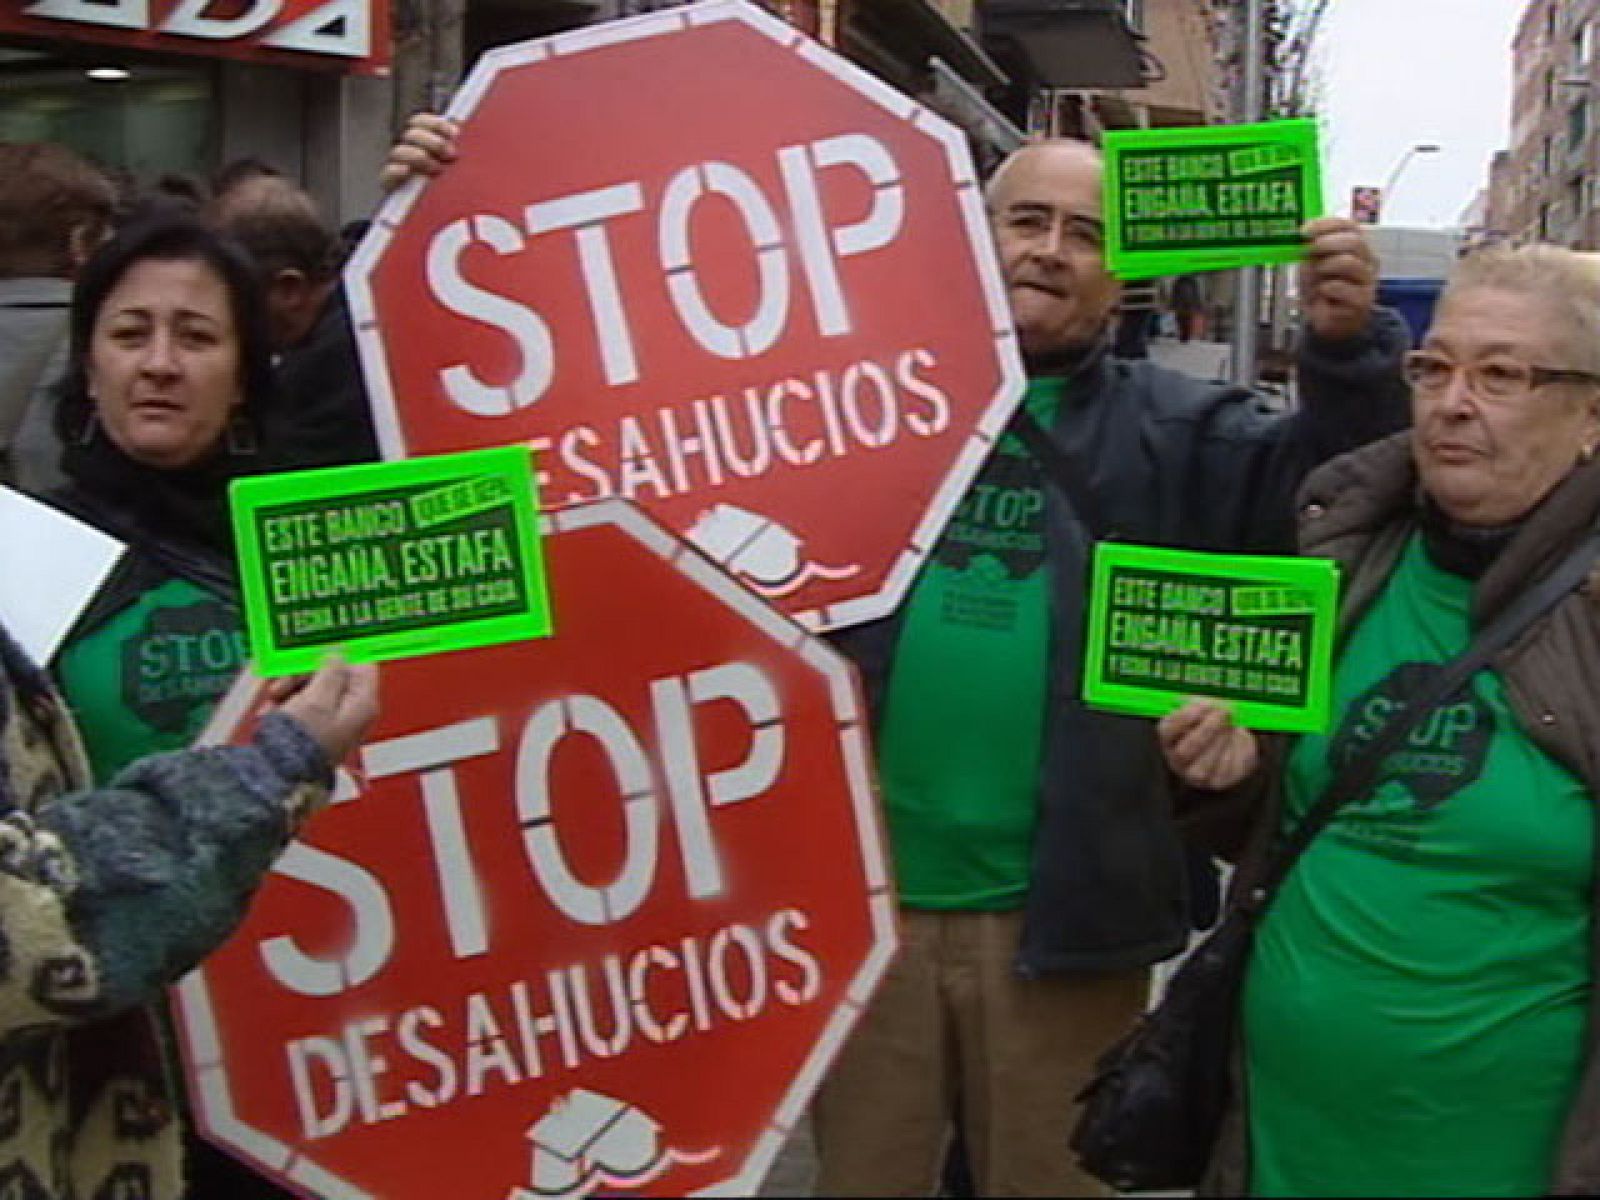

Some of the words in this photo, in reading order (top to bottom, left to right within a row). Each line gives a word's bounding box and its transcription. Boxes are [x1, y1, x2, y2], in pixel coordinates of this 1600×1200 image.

[1124, 156, 1166, 181] ESTE
[1167, 154, 1225, 180] BANCO
[1217, 181, 1298, 216] ESTAFA
[426, 134, 904, 416] STOP
[528, 349, 950, 502] ESAHUCIOS
[263, 513, 323, 552] ESTE
[325, 500, 405, 544] BANCO
[401, 527, 514, 584] ESTAFA
[1113, 576, 1159, 608] ESTE
[1160, 582, 1225, 616] BANCO
[1213, 622, 1301, 671] ESTAFA
[1354, 697, 1477, 748] SOP
[258, 662, 785, 996] STOP
[286, 908, 822, 1140] DESAHUCIOS
